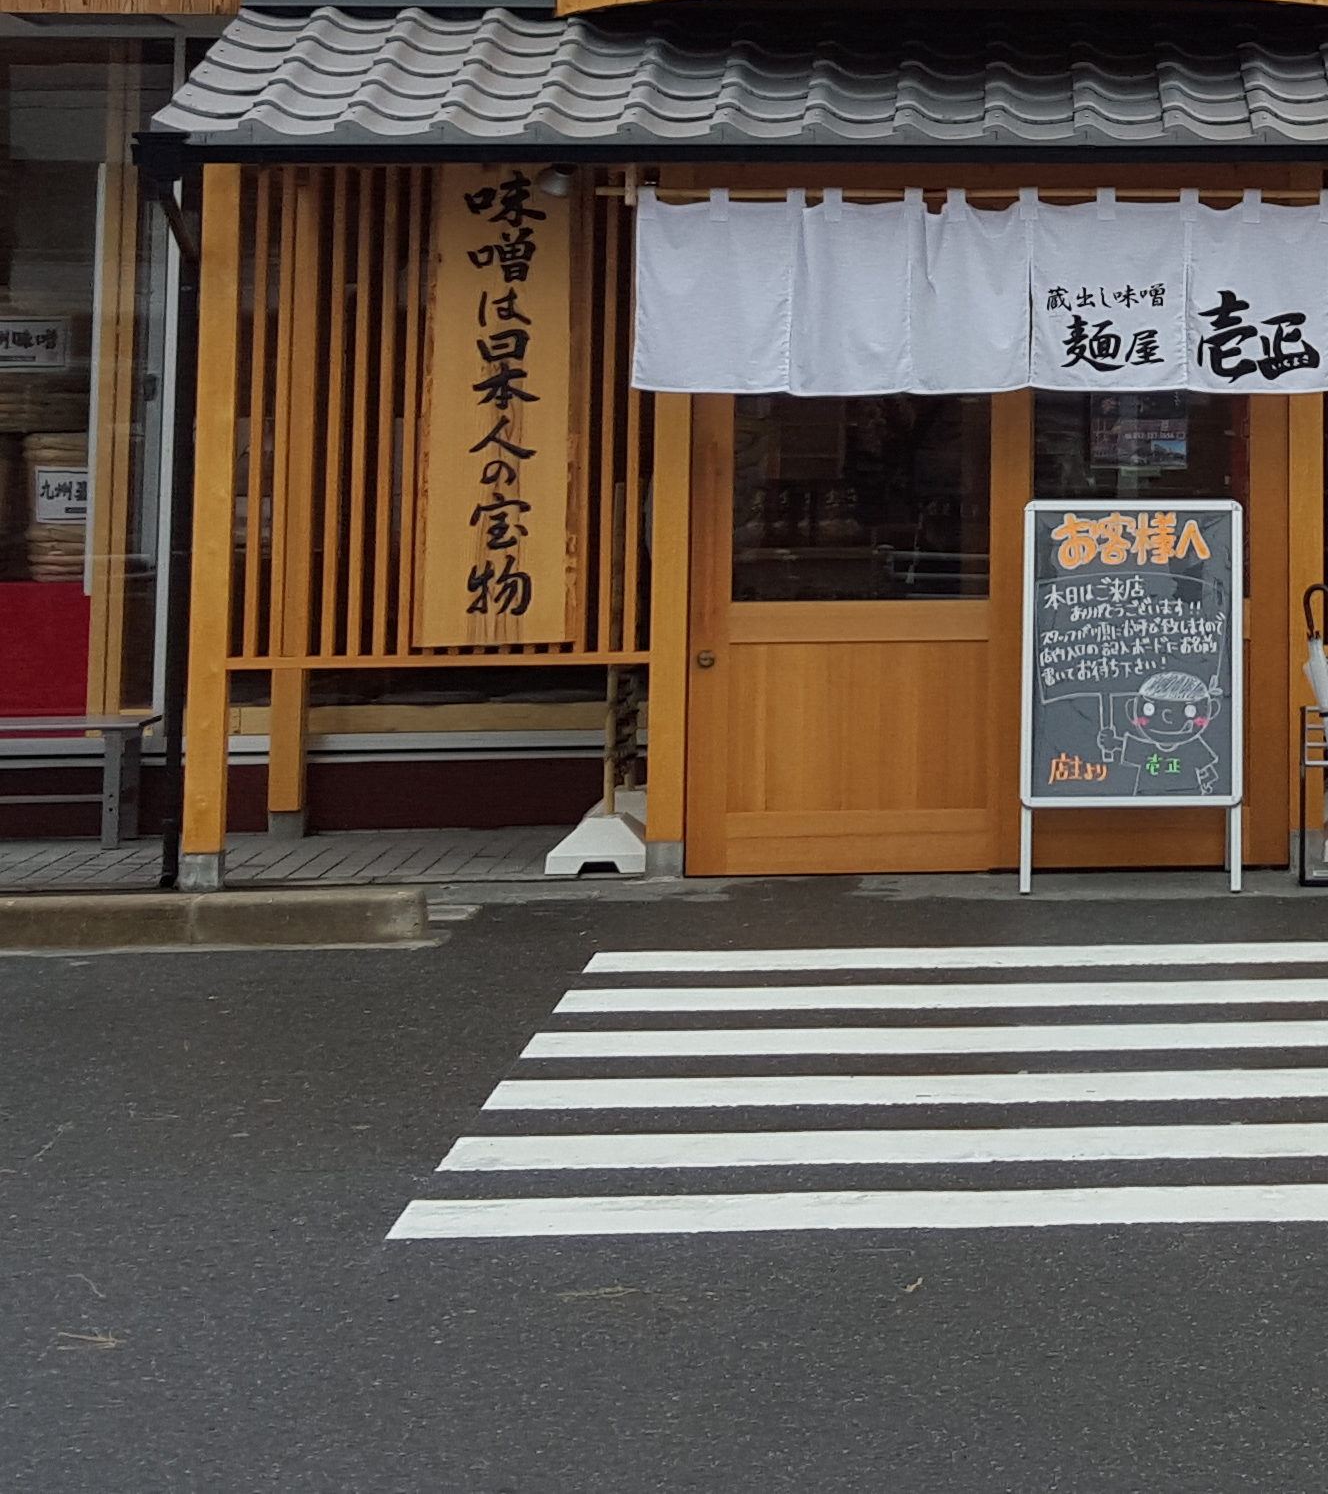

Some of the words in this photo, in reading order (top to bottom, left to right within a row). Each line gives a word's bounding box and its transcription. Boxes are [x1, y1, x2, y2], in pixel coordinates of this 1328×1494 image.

[1046, 283, 1166, 312] 蔵出し味噌
[1060, 314, 1166, 372] 麺屋
[462, 170, 547, 617] 味噌は日本人の宝物
[1051, 511, 1212, 570] お客様へ
[1044, 574, 1145, 610] 本日はご来店
[1048, 752, 1109, 785] 店主より
